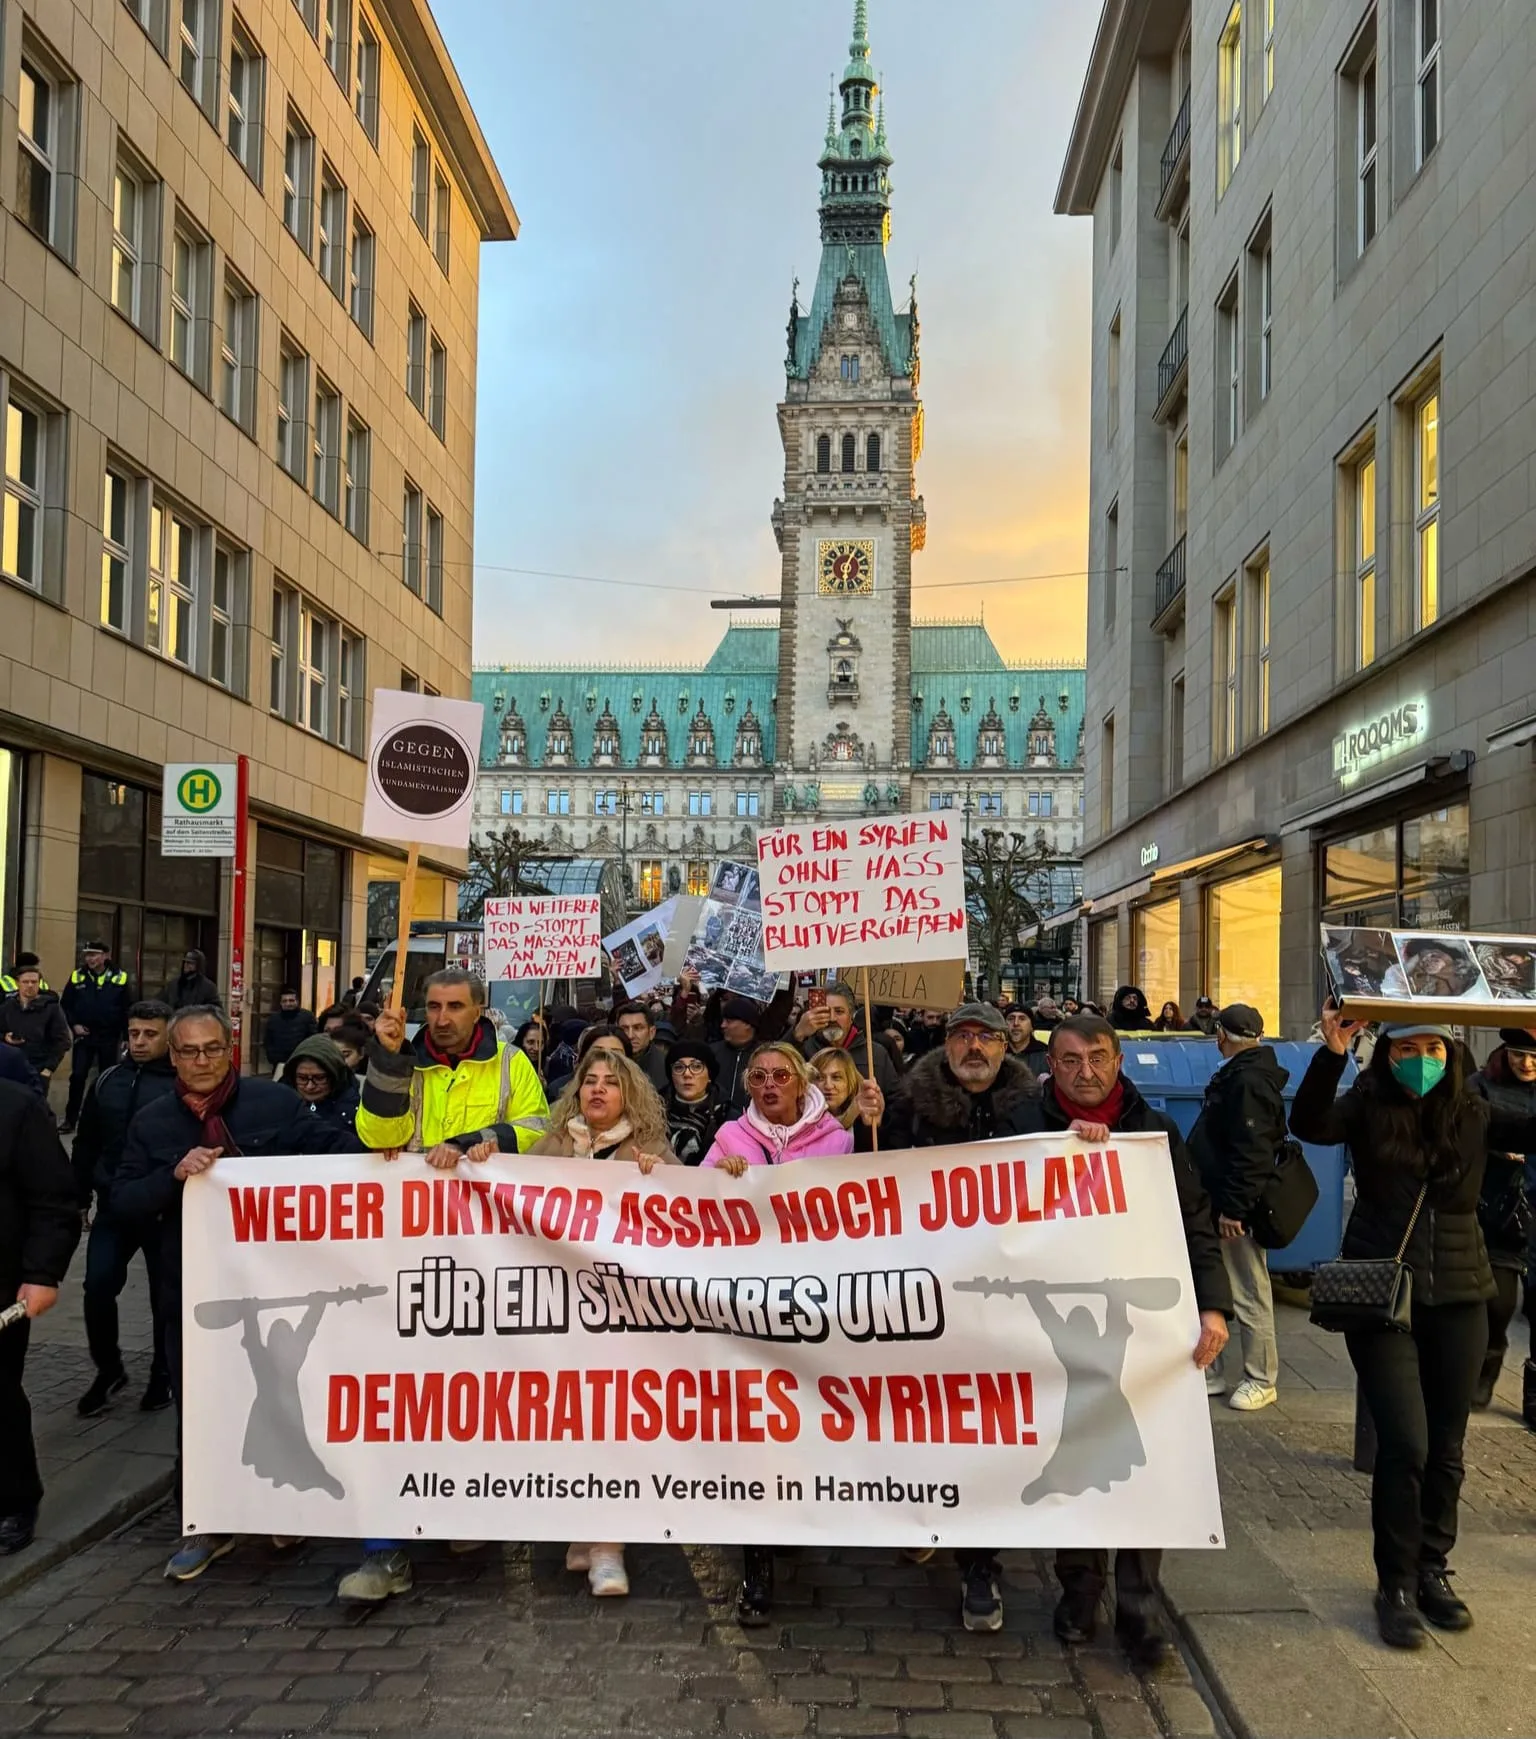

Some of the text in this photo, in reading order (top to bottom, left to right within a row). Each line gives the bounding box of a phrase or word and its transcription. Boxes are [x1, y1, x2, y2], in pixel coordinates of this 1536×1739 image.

[392, 739, 455, 759] GEGEN
[381, 760, 464, 778] ISLAMISTISCHEN
[381, 778, 464, 794] FUNDAMENTALISMUS
[758, 829, 803, 861] FÜR
[778, 857, 853, 885] OHNE
[486, 900, 523, 916] KEIN
[764, 886, 941, 917] STOPPT DAS
[487, 934, 600, 950] DAS MASSAKER
[499, 956, 597, 979] ALAWITEN!
[511, 949, 579, 962] AN DEN
[228, 1150, 1128, 1248] WEDER DIKTATOR ASSAD NOCH JOULANI
[397, 1256, 945, 1343] FÜR EIN SÄKULARES UND
[326, 1368, 1038, 1446] DEMOKRATISCHES SYRIEN!
[399, 1473, 960, 1507] Alle alevitischen Vereine in Hamburg
